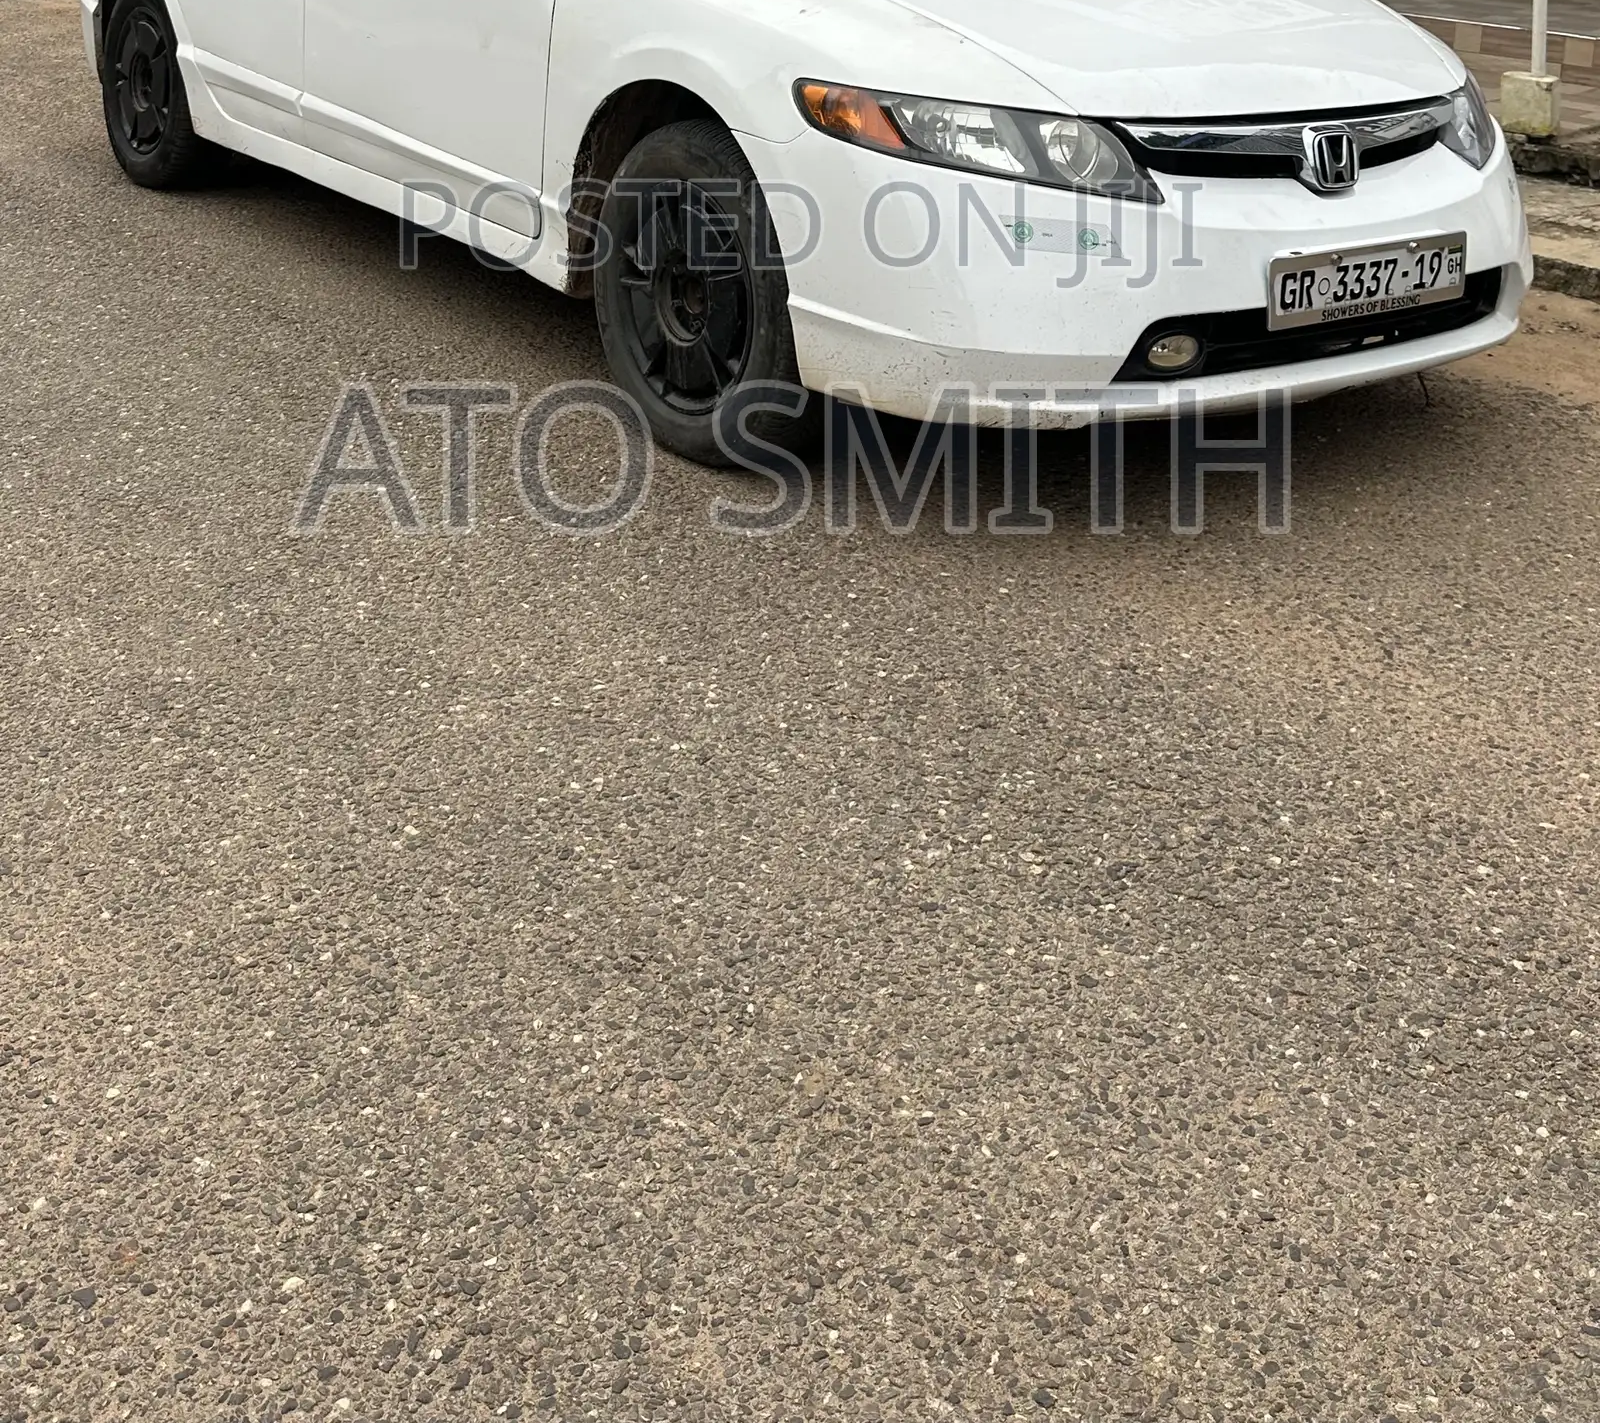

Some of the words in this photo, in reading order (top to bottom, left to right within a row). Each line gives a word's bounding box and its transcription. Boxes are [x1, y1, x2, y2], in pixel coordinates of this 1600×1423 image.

[1279, 269, 1316, 310] GR
[1447, 256, 1462, 275] GH
[1321, 301, 1365, 322] SHOWERS
[1366, 299, 1379, 313] OF
[1379, 294, 1421, 311] BLESSING
